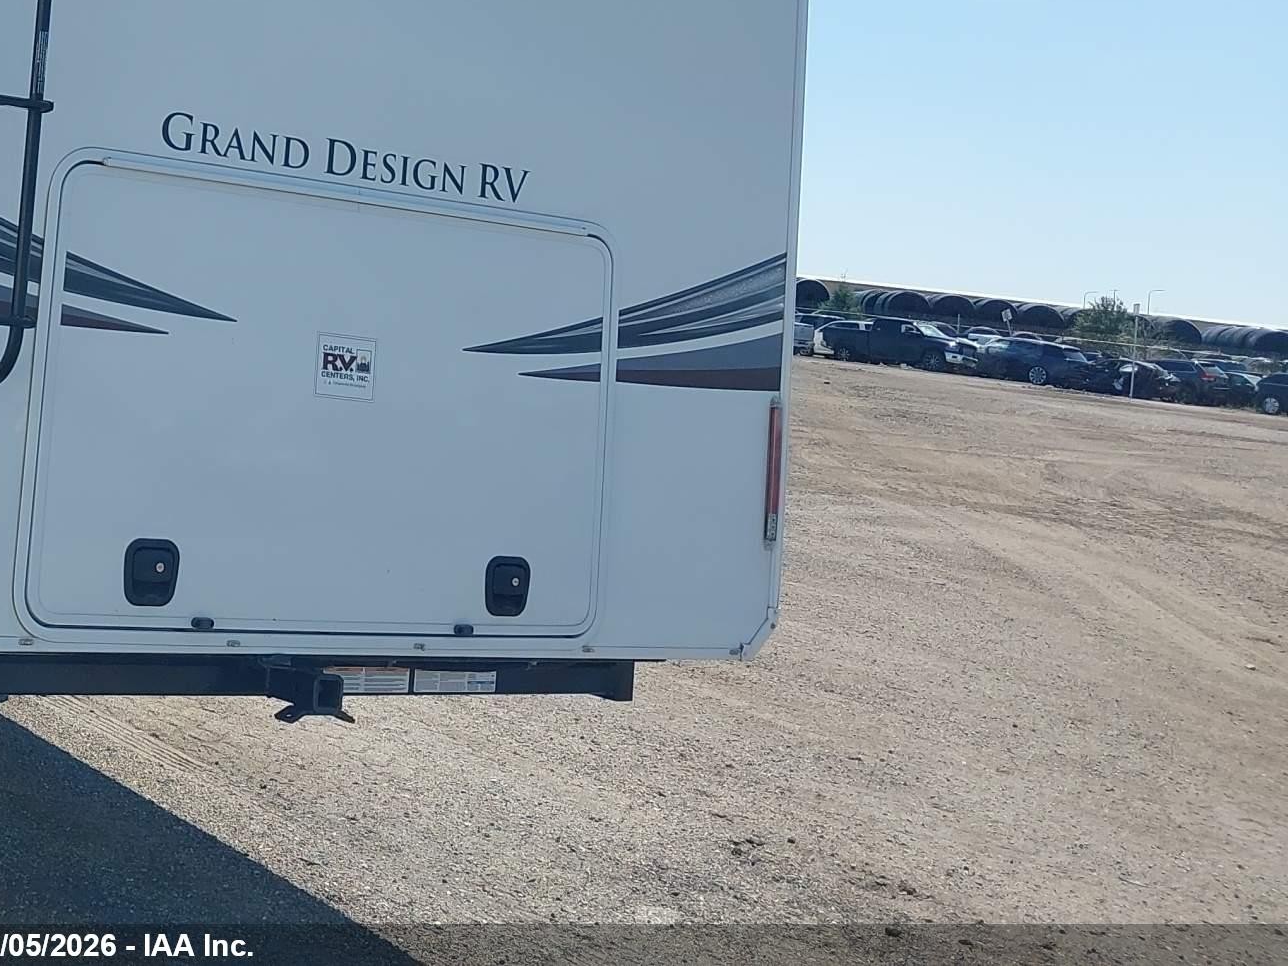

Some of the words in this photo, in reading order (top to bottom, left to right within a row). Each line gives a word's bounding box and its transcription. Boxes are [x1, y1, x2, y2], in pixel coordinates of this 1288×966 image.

[161, 111, 310, 169] GRAND
[325, 137, 466, 195] DESIGN
[478, 163, 531, 203] RV
[322, 344, 355, 355] CAPITAL
